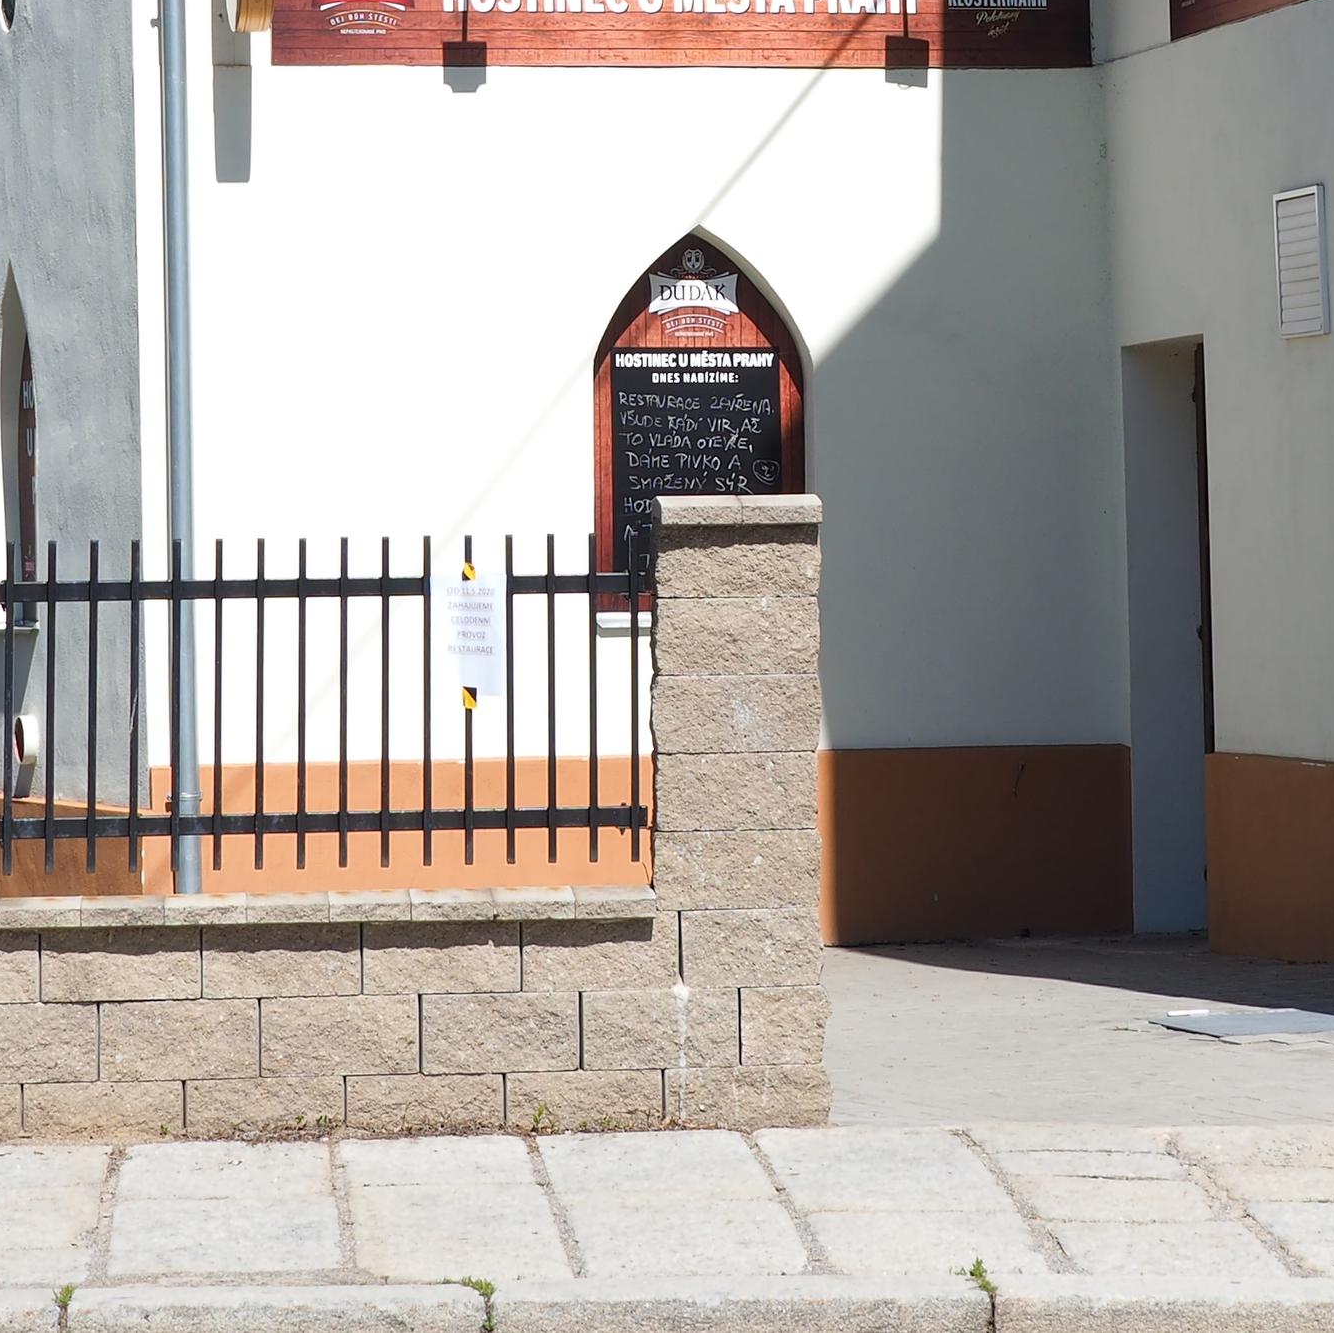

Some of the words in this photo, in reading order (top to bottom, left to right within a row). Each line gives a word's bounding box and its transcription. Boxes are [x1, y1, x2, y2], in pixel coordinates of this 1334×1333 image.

[659, 281, 726, 301] DUDÁK
[615, 353, 677, 368] HOSTINEC
[678, 353, 690, 368] U
[690, 350, 733, 368] MĚSTA
[733, 353, 774, 368] PRAHY
[651, 372, 680, 383] DNES
[683, 371, 739, 383] NABÍZÍME:
[619, 410, 663, 429] VŠUDE
[741, 417, 762, 434] AŽ
[619, 432, 644, 446] TO
[649, 430, 691, 450] VLÁDA
[625, 448, 670, 468] DÁME
[675, 452, 721, 472] PIVKO
[728, 454, 741, 470] A
[628, 471, 707, 493] SMAŽENÝ
[715, 473, 754, 495] SÝR
